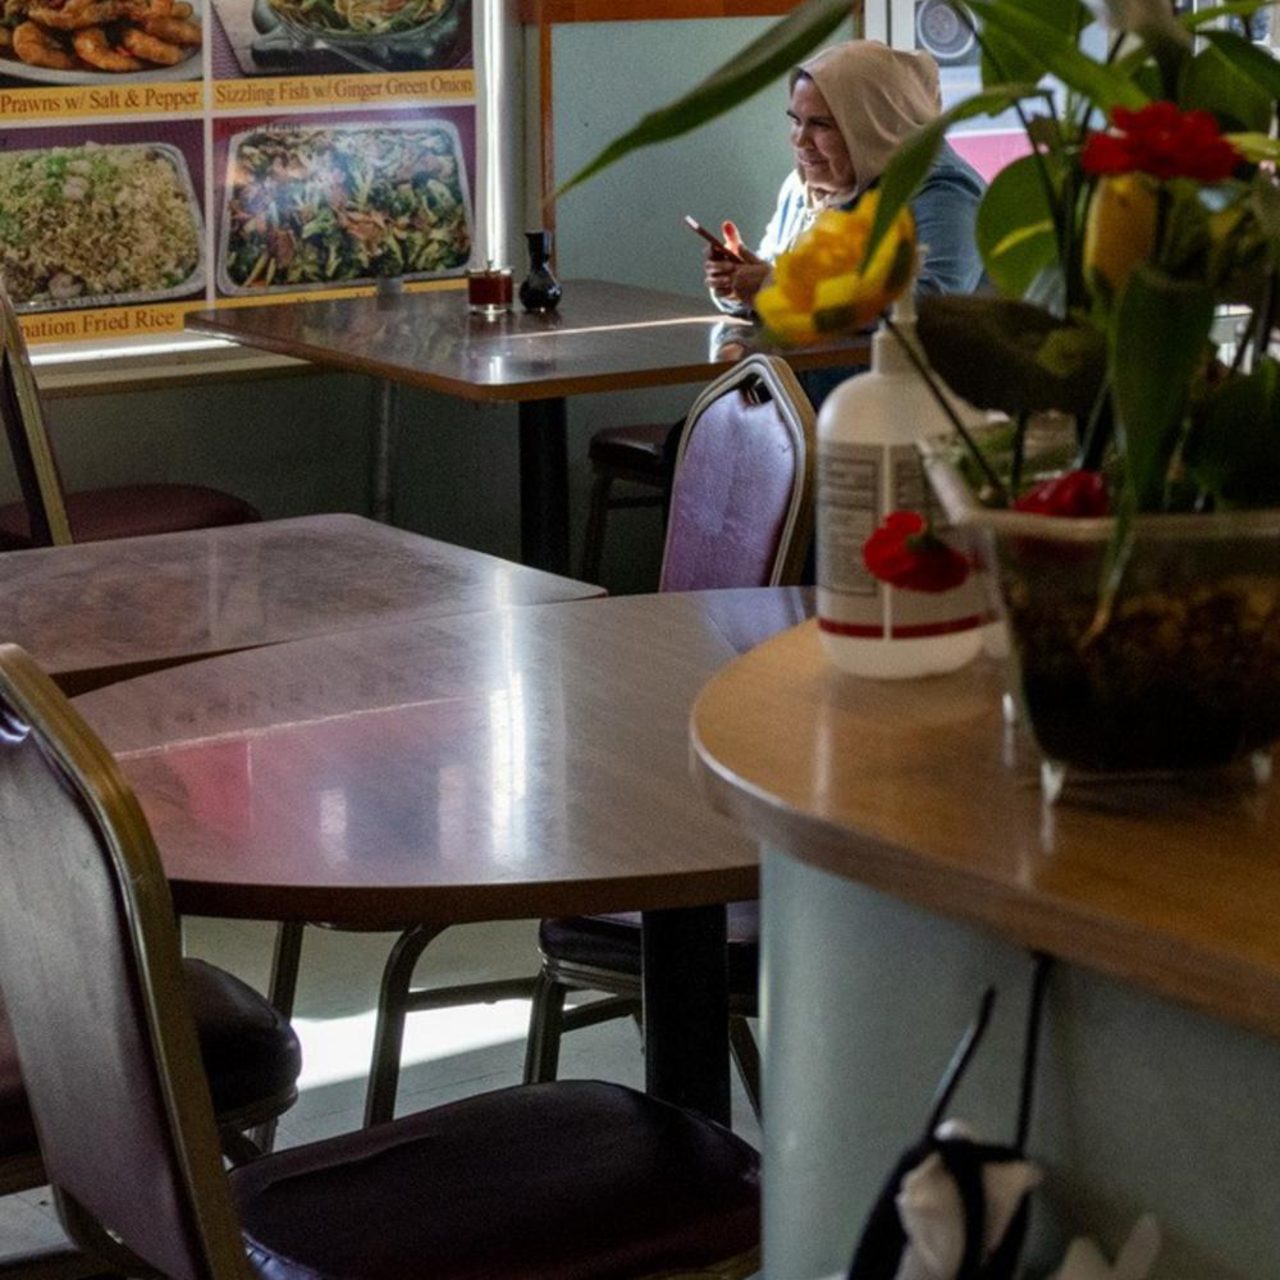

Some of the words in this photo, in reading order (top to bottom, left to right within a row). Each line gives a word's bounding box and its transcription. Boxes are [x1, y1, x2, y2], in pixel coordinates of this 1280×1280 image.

[1, 91, 62, 113] Prawns
[64, 88, 86, 111] w/
[90, 85, 125, 110] Salt
[129, 89, 141, 107] &
[144, 88, 199, 112] Pepper
[216, 83, 276, 106] Sizzling
[279, 80, 310, 102] Fish
[312, 79, 334, 101] w/
[335, 78, 383, 102] Ginger
[385, 76, 429, 97] Green
[430, 75, 473, 96] Onion
[20, 317, 77, 339] nation
[82, 311, 130, 334] Fried
[134, 309, 176, 330] Rice
